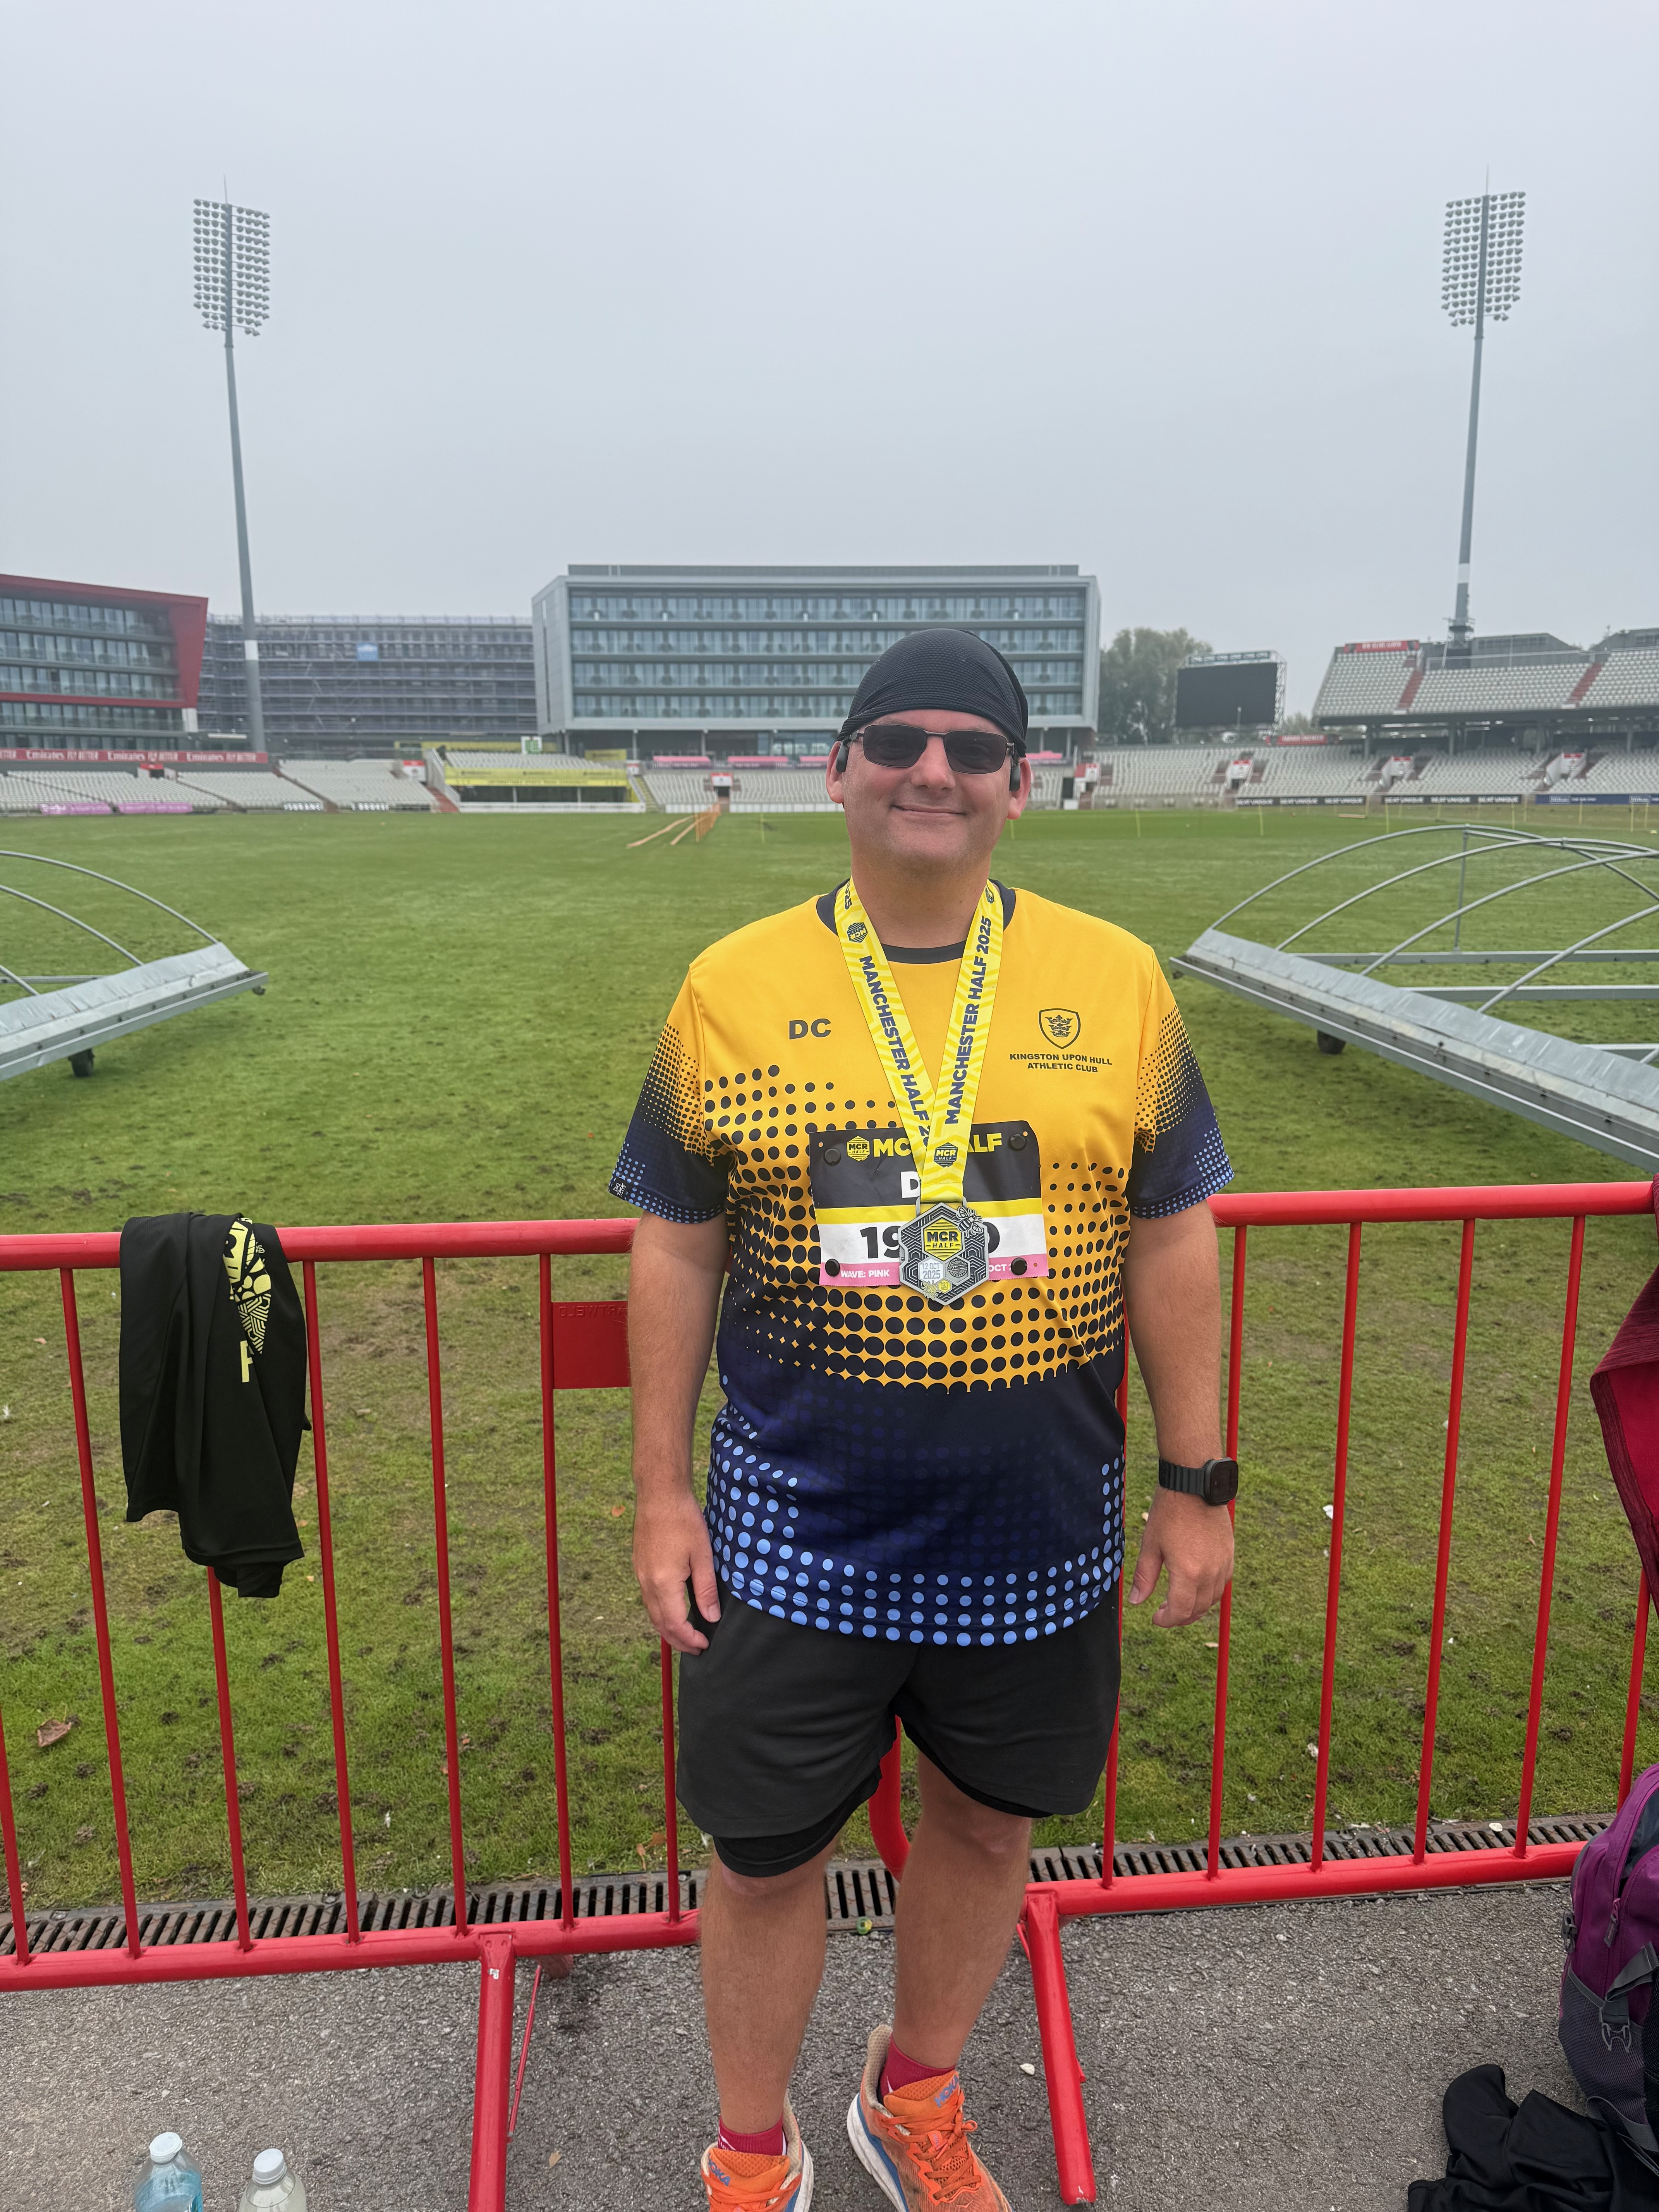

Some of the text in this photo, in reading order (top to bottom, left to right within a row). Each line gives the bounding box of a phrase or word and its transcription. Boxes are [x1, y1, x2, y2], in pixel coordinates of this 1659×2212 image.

[26, 750, 65, 760] Emirates
[107, 751, 146, 760] Emirates
[186, 752, 225, 762] Emirates
[850, 927, 867, 939] MCR
[976, 916, 992, 955] 2025
[968, 955, 987, 1000] HALF
[789, 1018, 831, 1039] DC
[859, 955, 910, 1071] MANCHESTER
[901, 1074, 929, 1121] HALF
[945, 1003, 980, 1125] MANCHESTER
[1062, 1054, 1087, 1062] UPON
[1089, 1056, 1113, 1065] HULL
[1075, 1064, 1098, 1073] CLUB
[873, 1138, 912, 1157] MC
[927, 1230, 958, 1243] MCR
[840, 1269, 866, 1278] WAVE:
[868, 1269, 890, 1278] PINK
[923, 1270, 941, 1279] 2025
